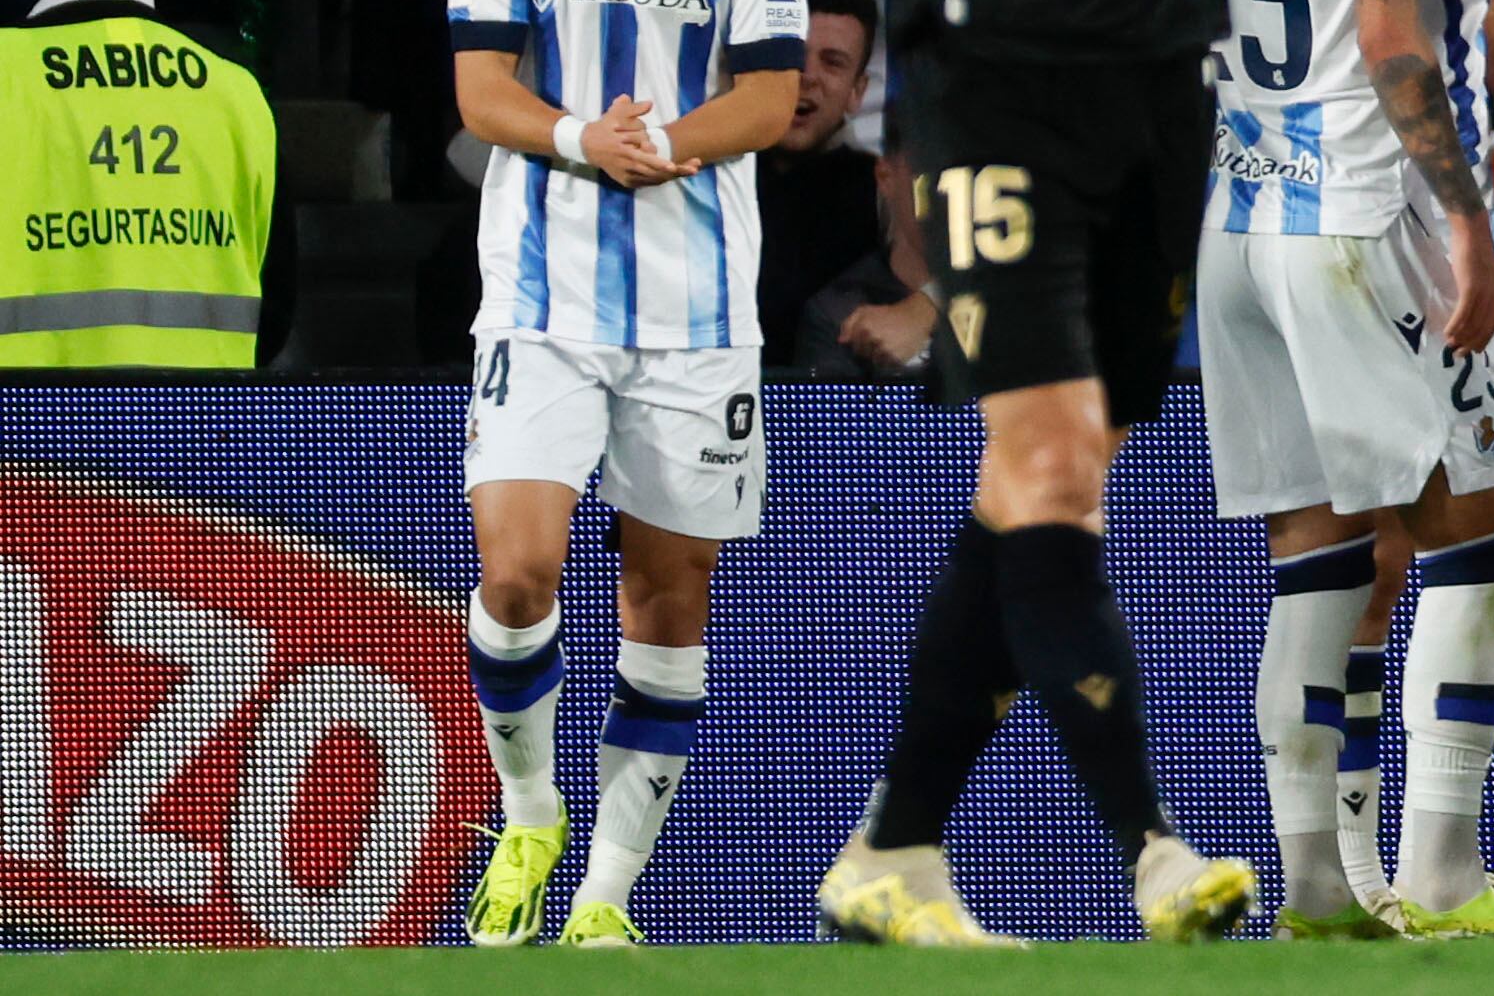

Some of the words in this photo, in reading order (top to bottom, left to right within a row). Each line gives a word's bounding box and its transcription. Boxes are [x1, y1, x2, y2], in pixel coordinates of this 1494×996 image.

[42, 43, 208, 89] SABICO
[89, 124, 181, 175] 412
[936, 164, 1035, 271] 15
